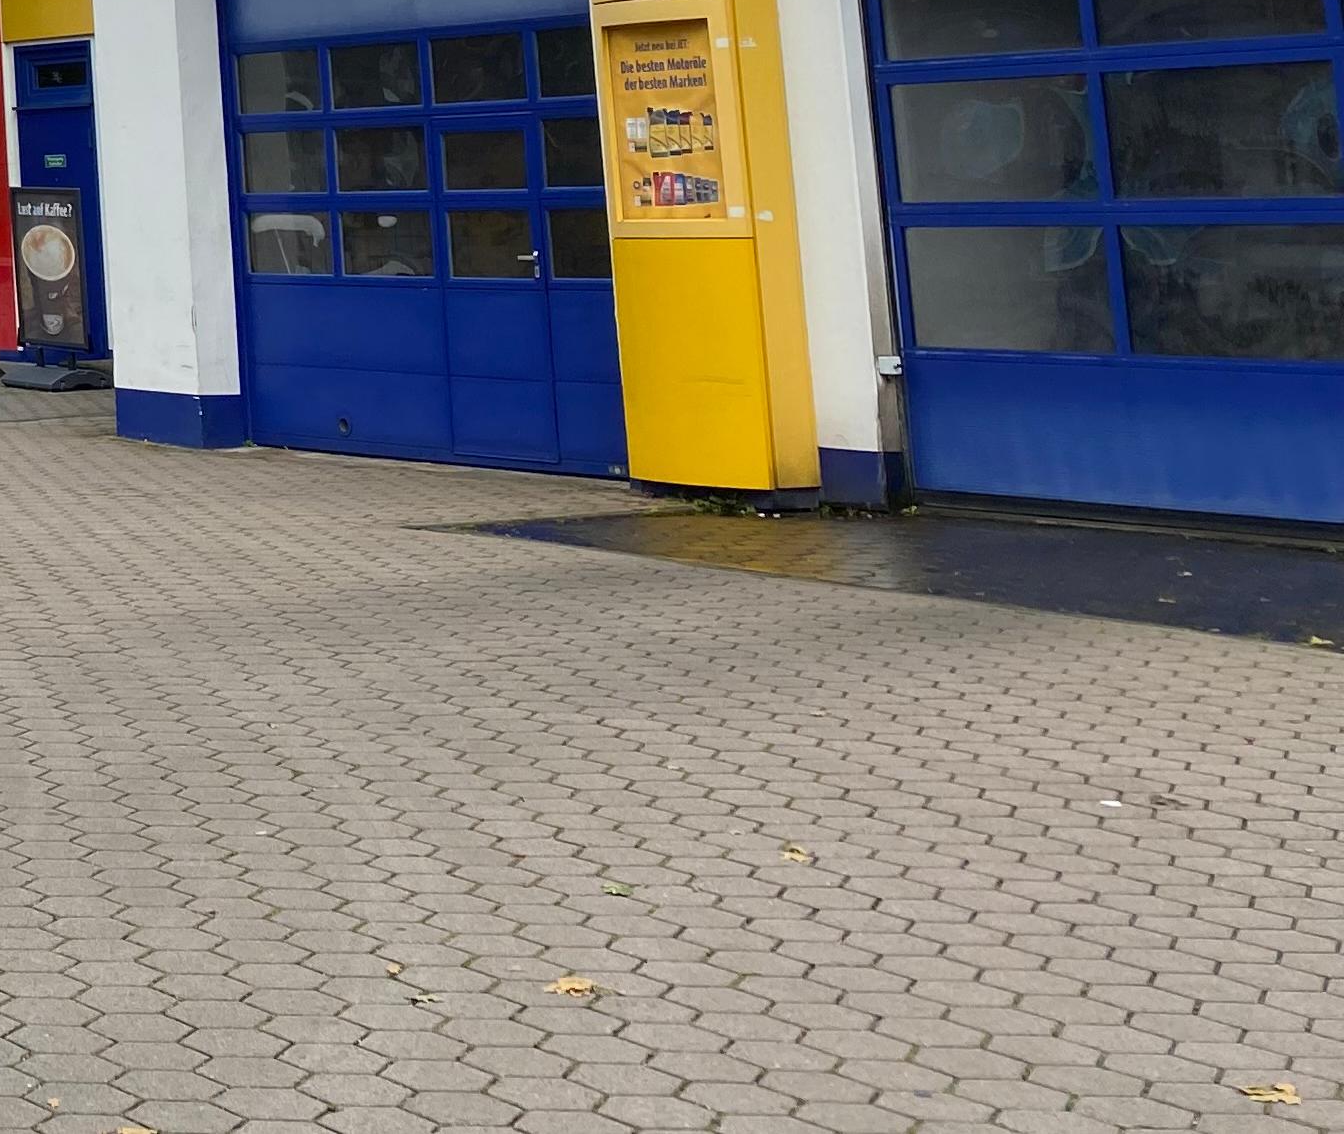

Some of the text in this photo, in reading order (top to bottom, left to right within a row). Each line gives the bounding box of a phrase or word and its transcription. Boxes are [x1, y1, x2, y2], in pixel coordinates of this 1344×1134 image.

[620, 55, 707, 74] Die besten Motoröle
[624, 72, 708, 90] der besten Marken!
[17, 202, 32, 216] Lust
[45, 202, 72, 217] Kaffee?
